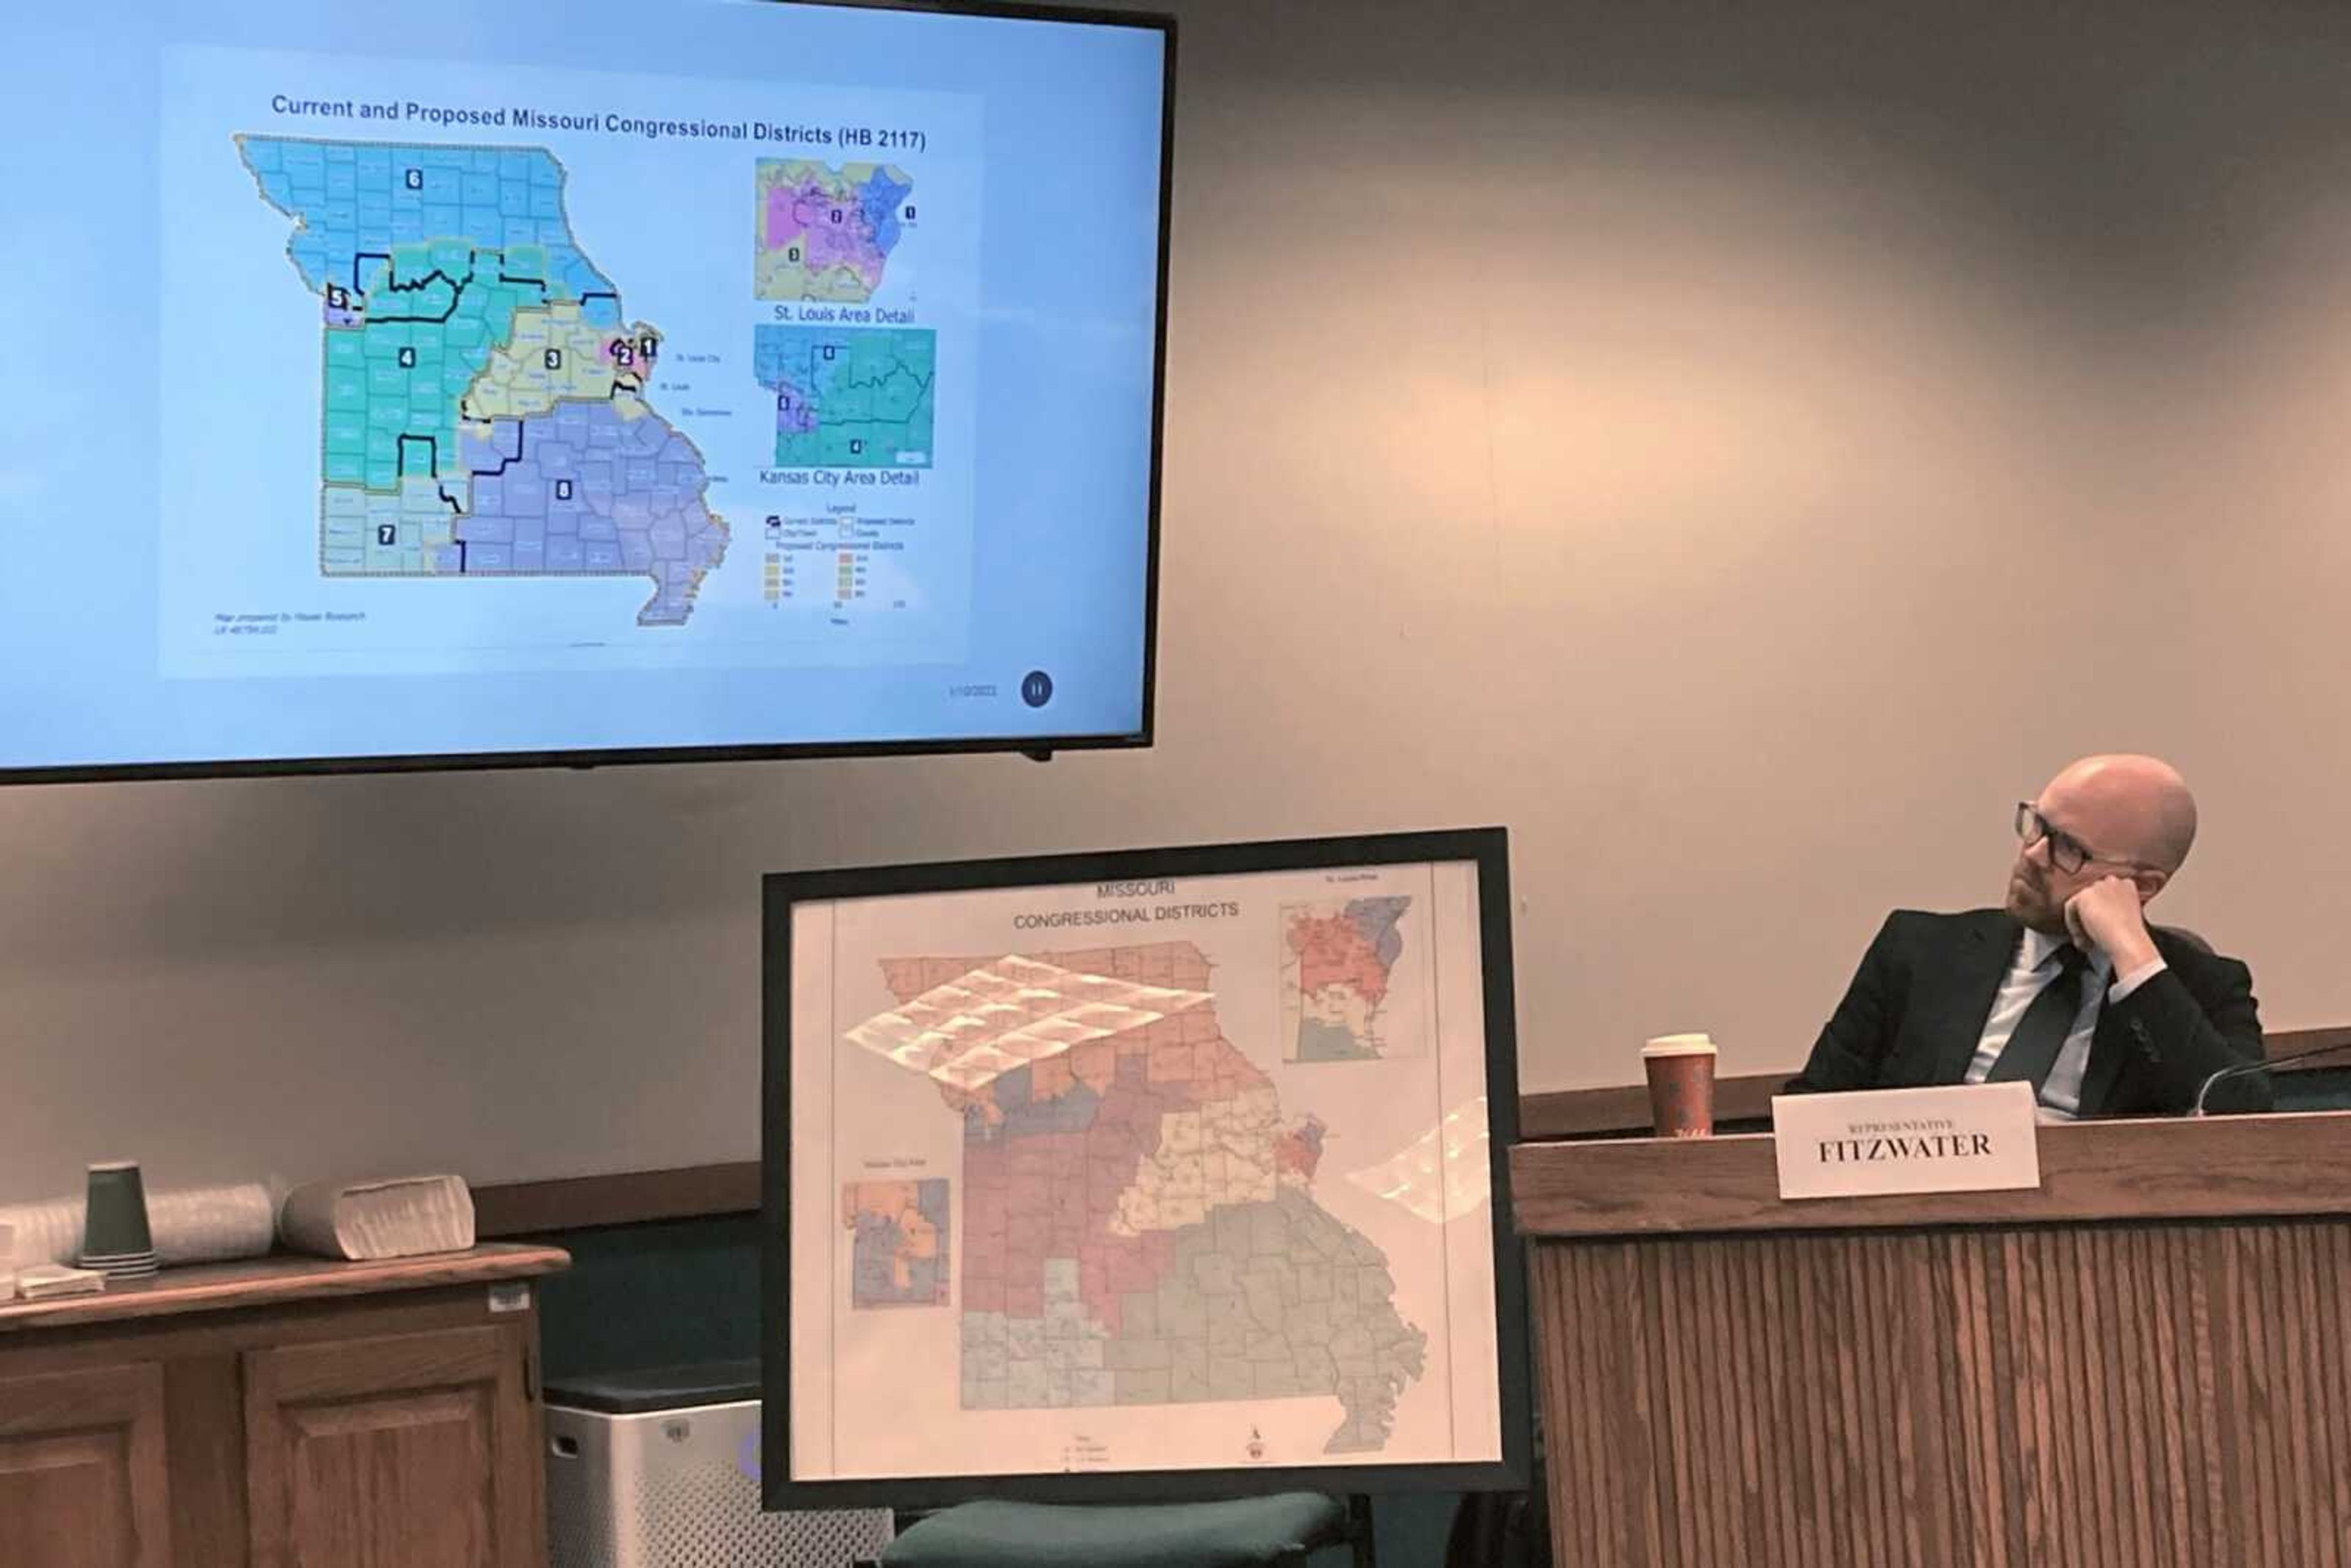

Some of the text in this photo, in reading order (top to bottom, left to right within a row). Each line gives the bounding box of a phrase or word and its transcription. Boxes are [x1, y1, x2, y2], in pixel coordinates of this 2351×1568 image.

[271, 94, 926, 153] Current and Proposed Missouri Congressional Districts (HB 2117)
[408, 171, 421, 187] 6
[331, 289, 343, 307] 5
[774, 306, 915, 324] St. Louis Area Detail
[401, 349, 413, 366] 4
[547, 351, 558, 367] 3
[620, 348, 630, 365] 2
[760, 470, 920, 487] Kansas City Area Detail
[559, 481, 569, 498] 8
[381, 527, 392, 543] 7
[1096, 880, 1176, 899] MISSOURI
[1013, 901, 1239, 929] CONGRESSIONAL DISTRICTS
[1820, 1133, 1991, 1163] FITZWATER
